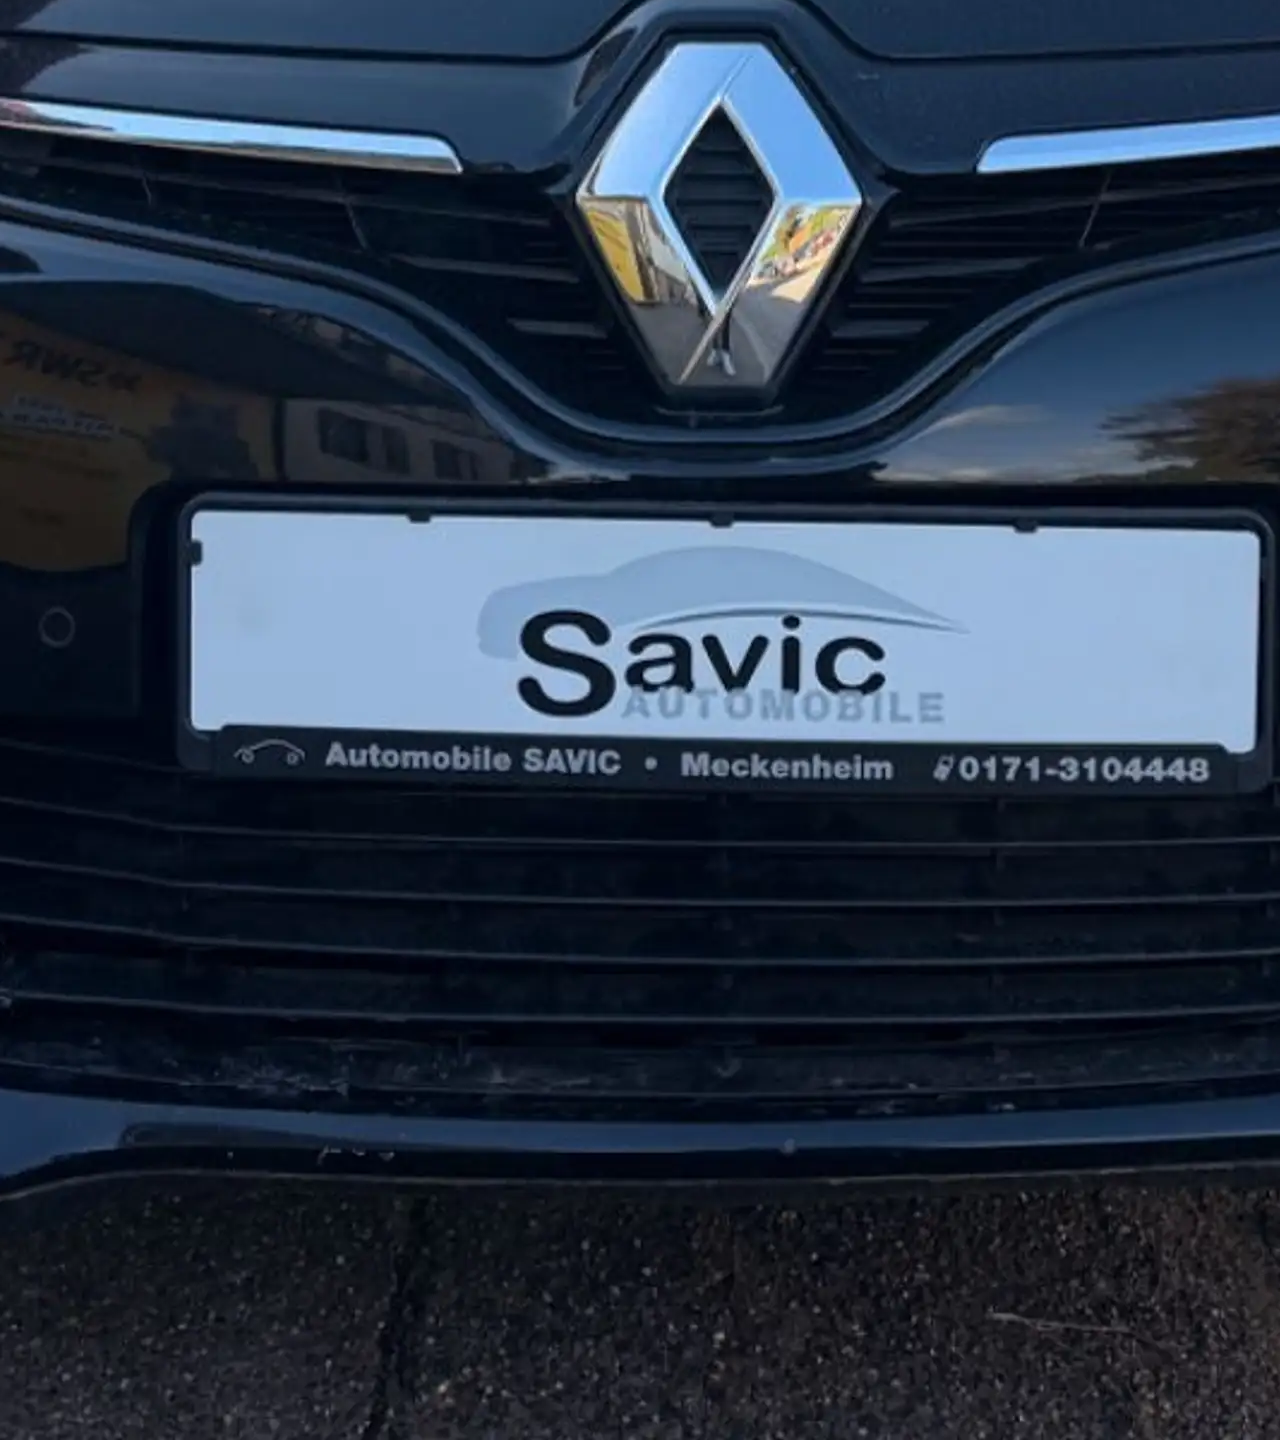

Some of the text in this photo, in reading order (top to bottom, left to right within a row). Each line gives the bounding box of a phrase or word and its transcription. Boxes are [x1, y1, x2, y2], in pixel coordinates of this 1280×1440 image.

[518, 610, 886, 717] Savic
[622, 687, 945, 724] AUTOMOBILE
[325, 742, 1211, 783] Automobile SAVIC Meckenheim 0171-3104448
